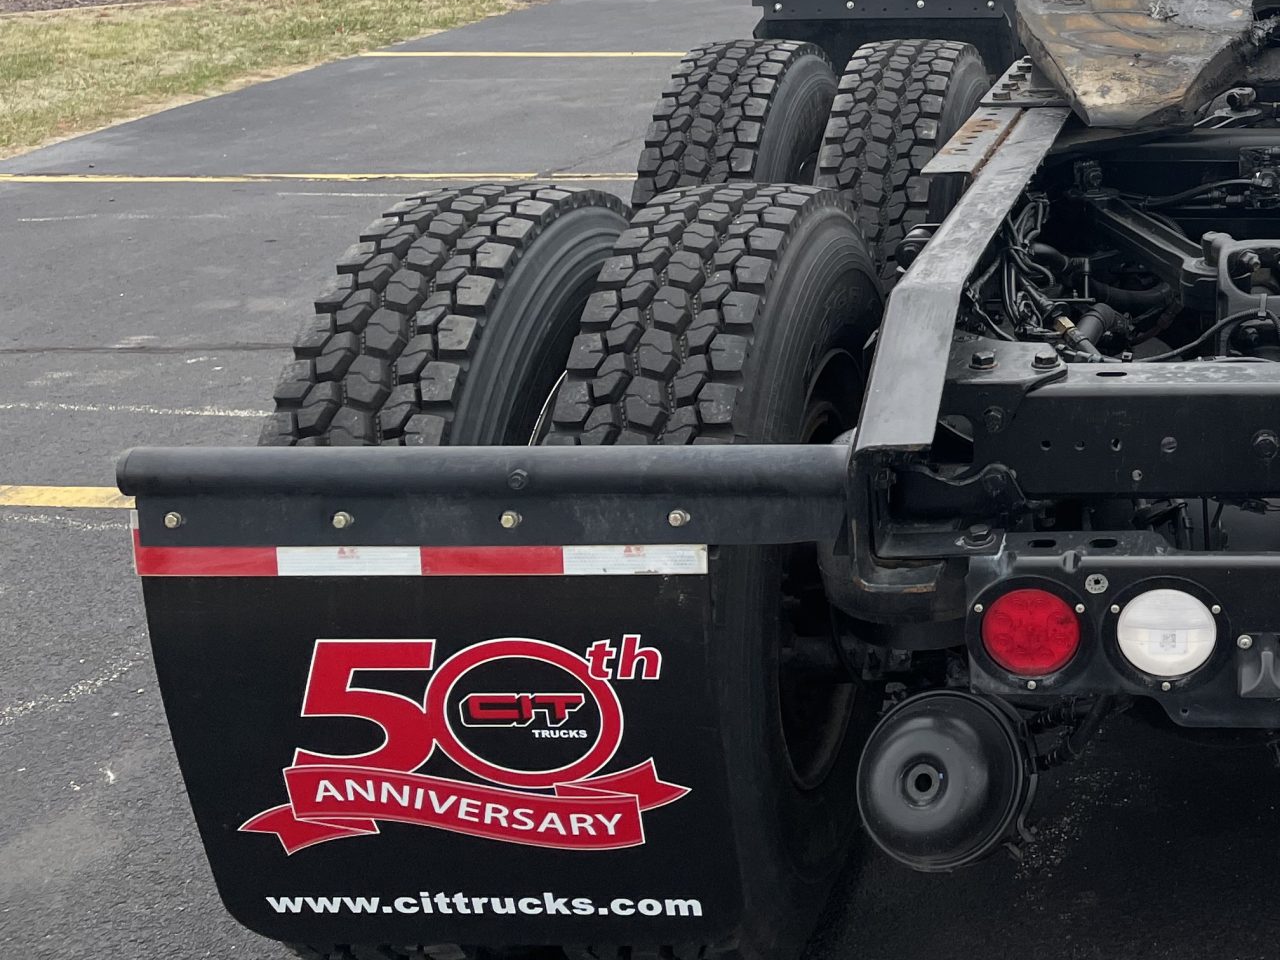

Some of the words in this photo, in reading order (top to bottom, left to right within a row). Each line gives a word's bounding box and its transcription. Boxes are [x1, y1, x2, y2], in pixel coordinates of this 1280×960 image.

[459, 692, 586, 728] CIT
[531, 729, 588, 739] TRUCKS
[315, 778, 623, 836] ANNIVERSARY
[265, 892, 704, 918] www.cittrucks.com
